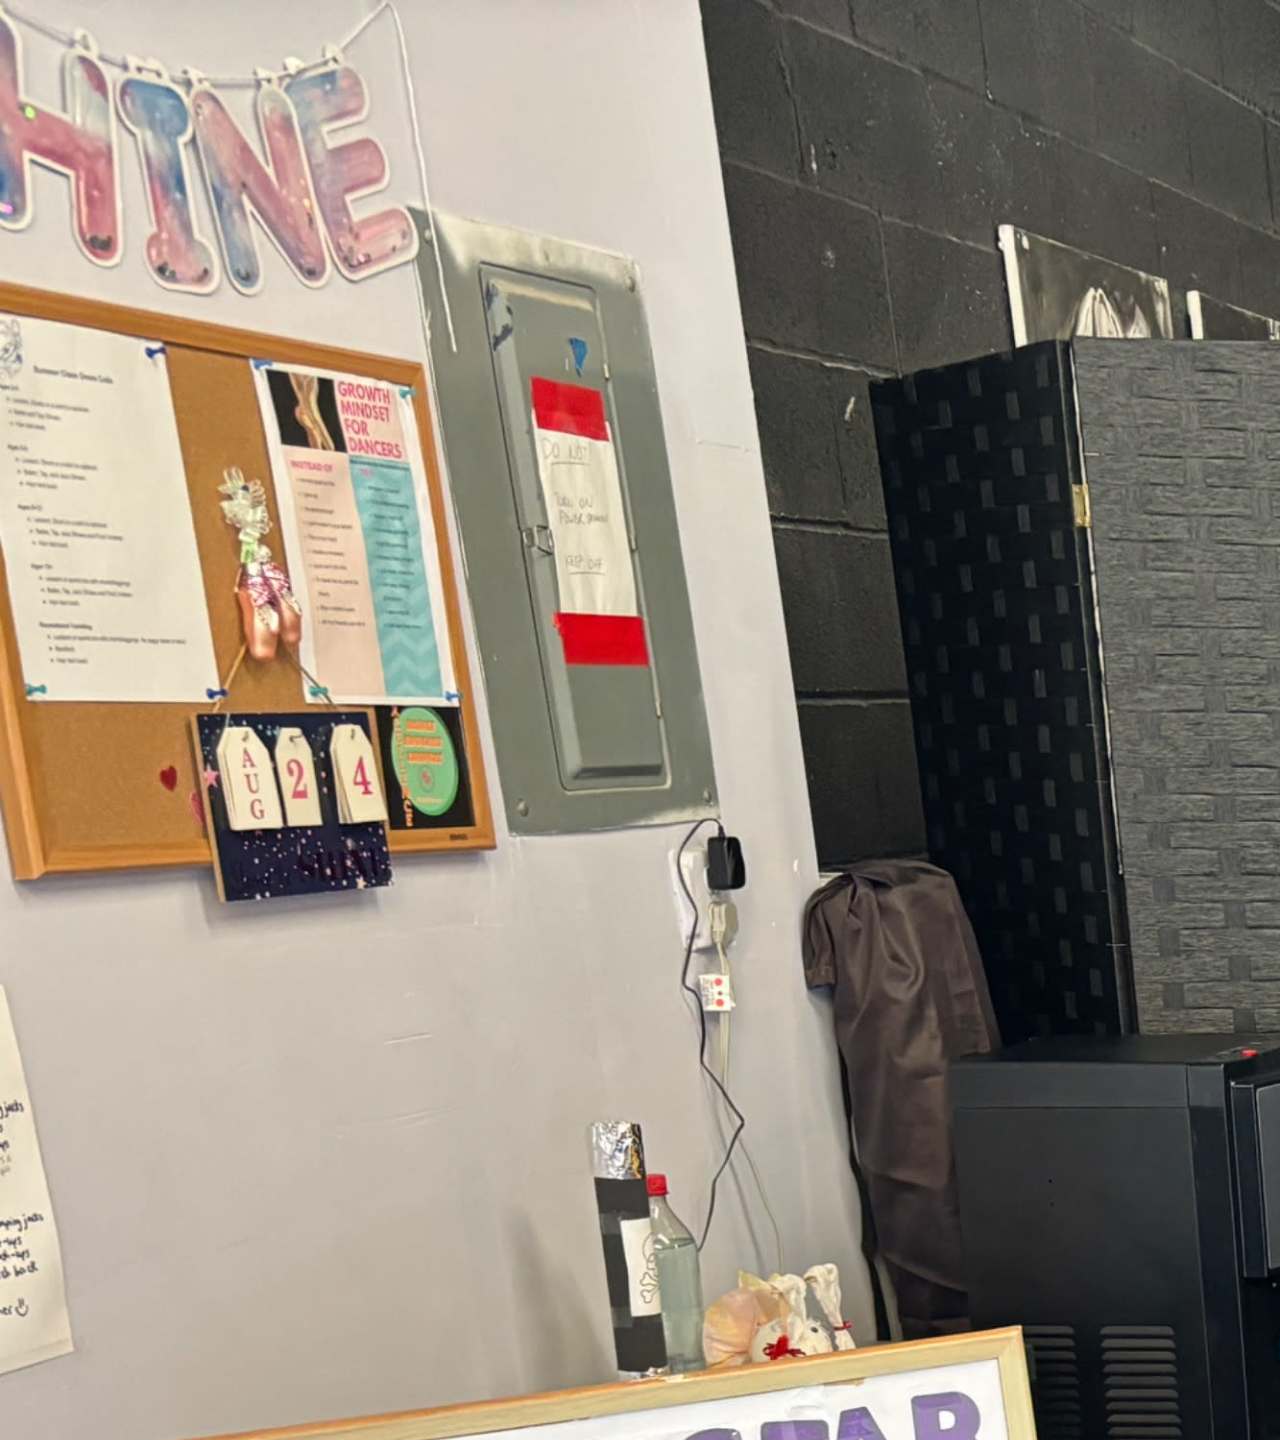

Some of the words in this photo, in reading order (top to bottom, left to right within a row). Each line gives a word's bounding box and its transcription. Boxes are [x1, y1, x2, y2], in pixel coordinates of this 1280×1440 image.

[338, 381, 391, 404] GROWTH
[341, 400, 390, 422] MINDSET
[344, 419, 369, 436] FOR
[349, 437, 402, 458] DANCERS
[242, 749, 264, 820] AUG
